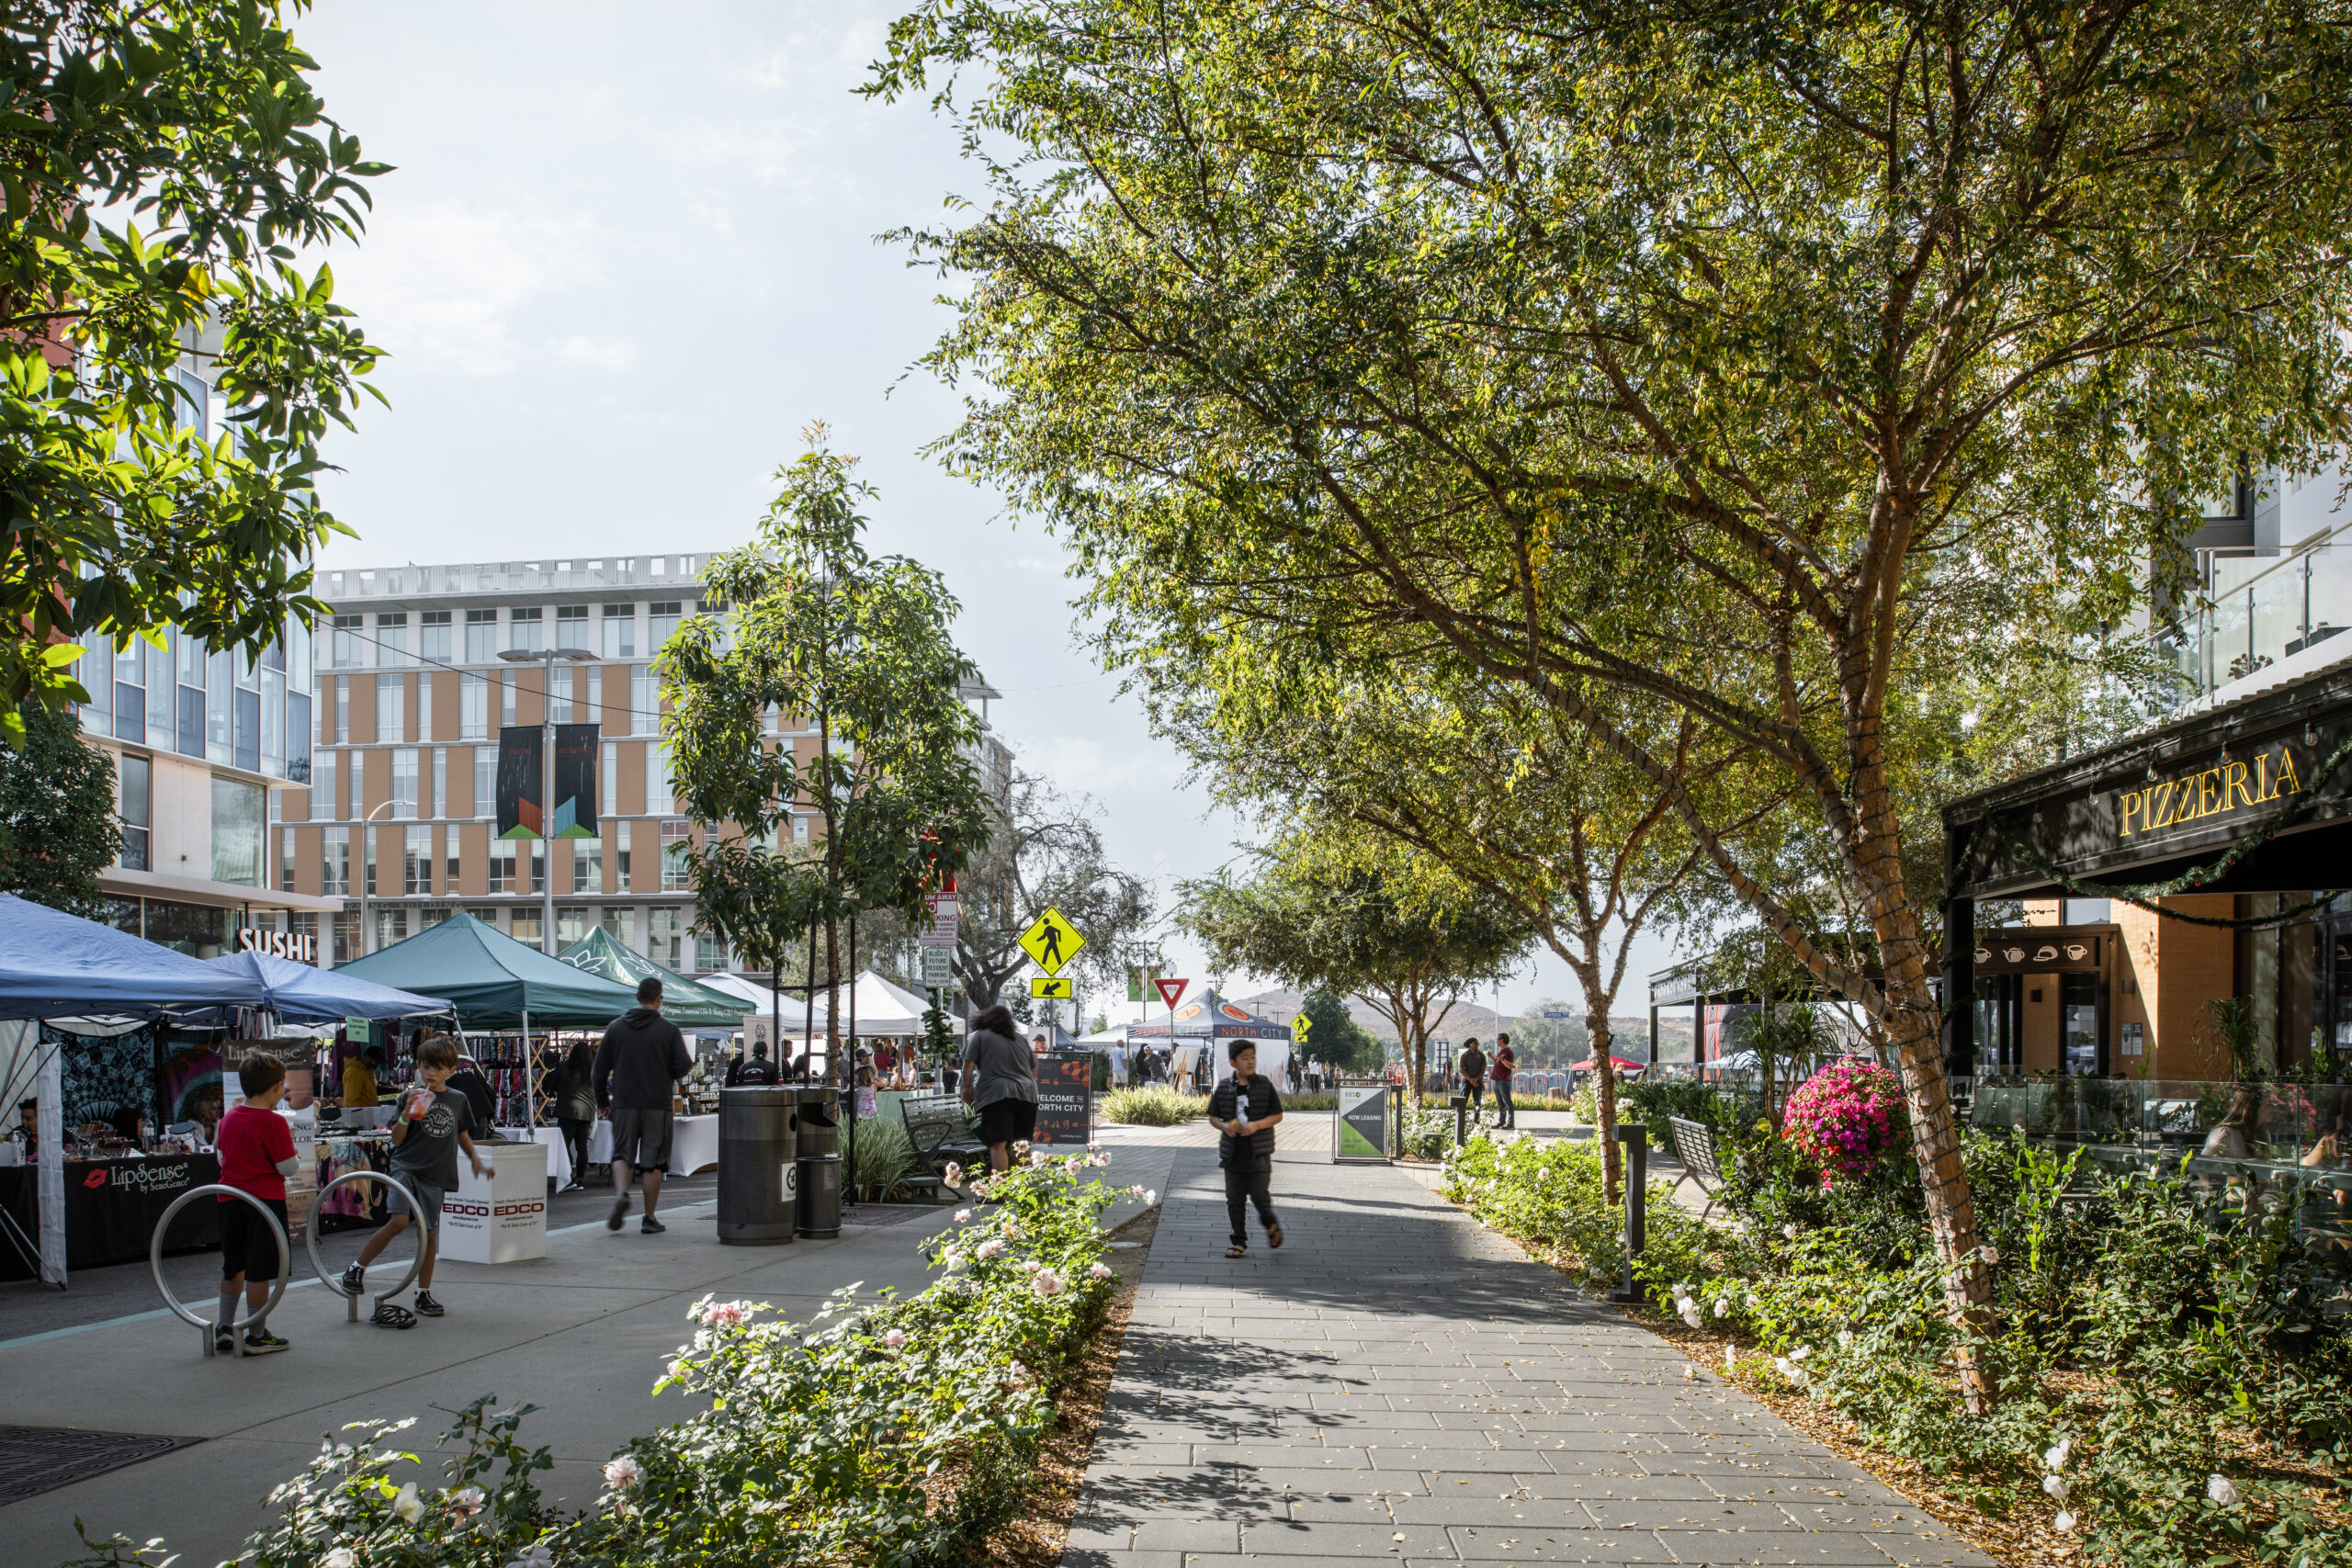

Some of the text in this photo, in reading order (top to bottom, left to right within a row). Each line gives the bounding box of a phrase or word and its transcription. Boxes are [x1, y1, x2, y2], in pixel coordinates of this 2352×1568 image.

[2120, 747, 2301, 837] PIZZERIA
[399, 901, 463, 910] BUILDING
[240, 928, 311, 961] SUSHI
[1135, 1025, 1203, 1037] NORTH CITY
[1221, 1026, 1283, 1038] NORTH CITY
[1037, 1094, 1075, 1102] ELCOME
[141, 1183, 148, 1193] by
[442, 1202, 489, 1216] EDCO
[493, 1202, 545, 1216] EDCO
